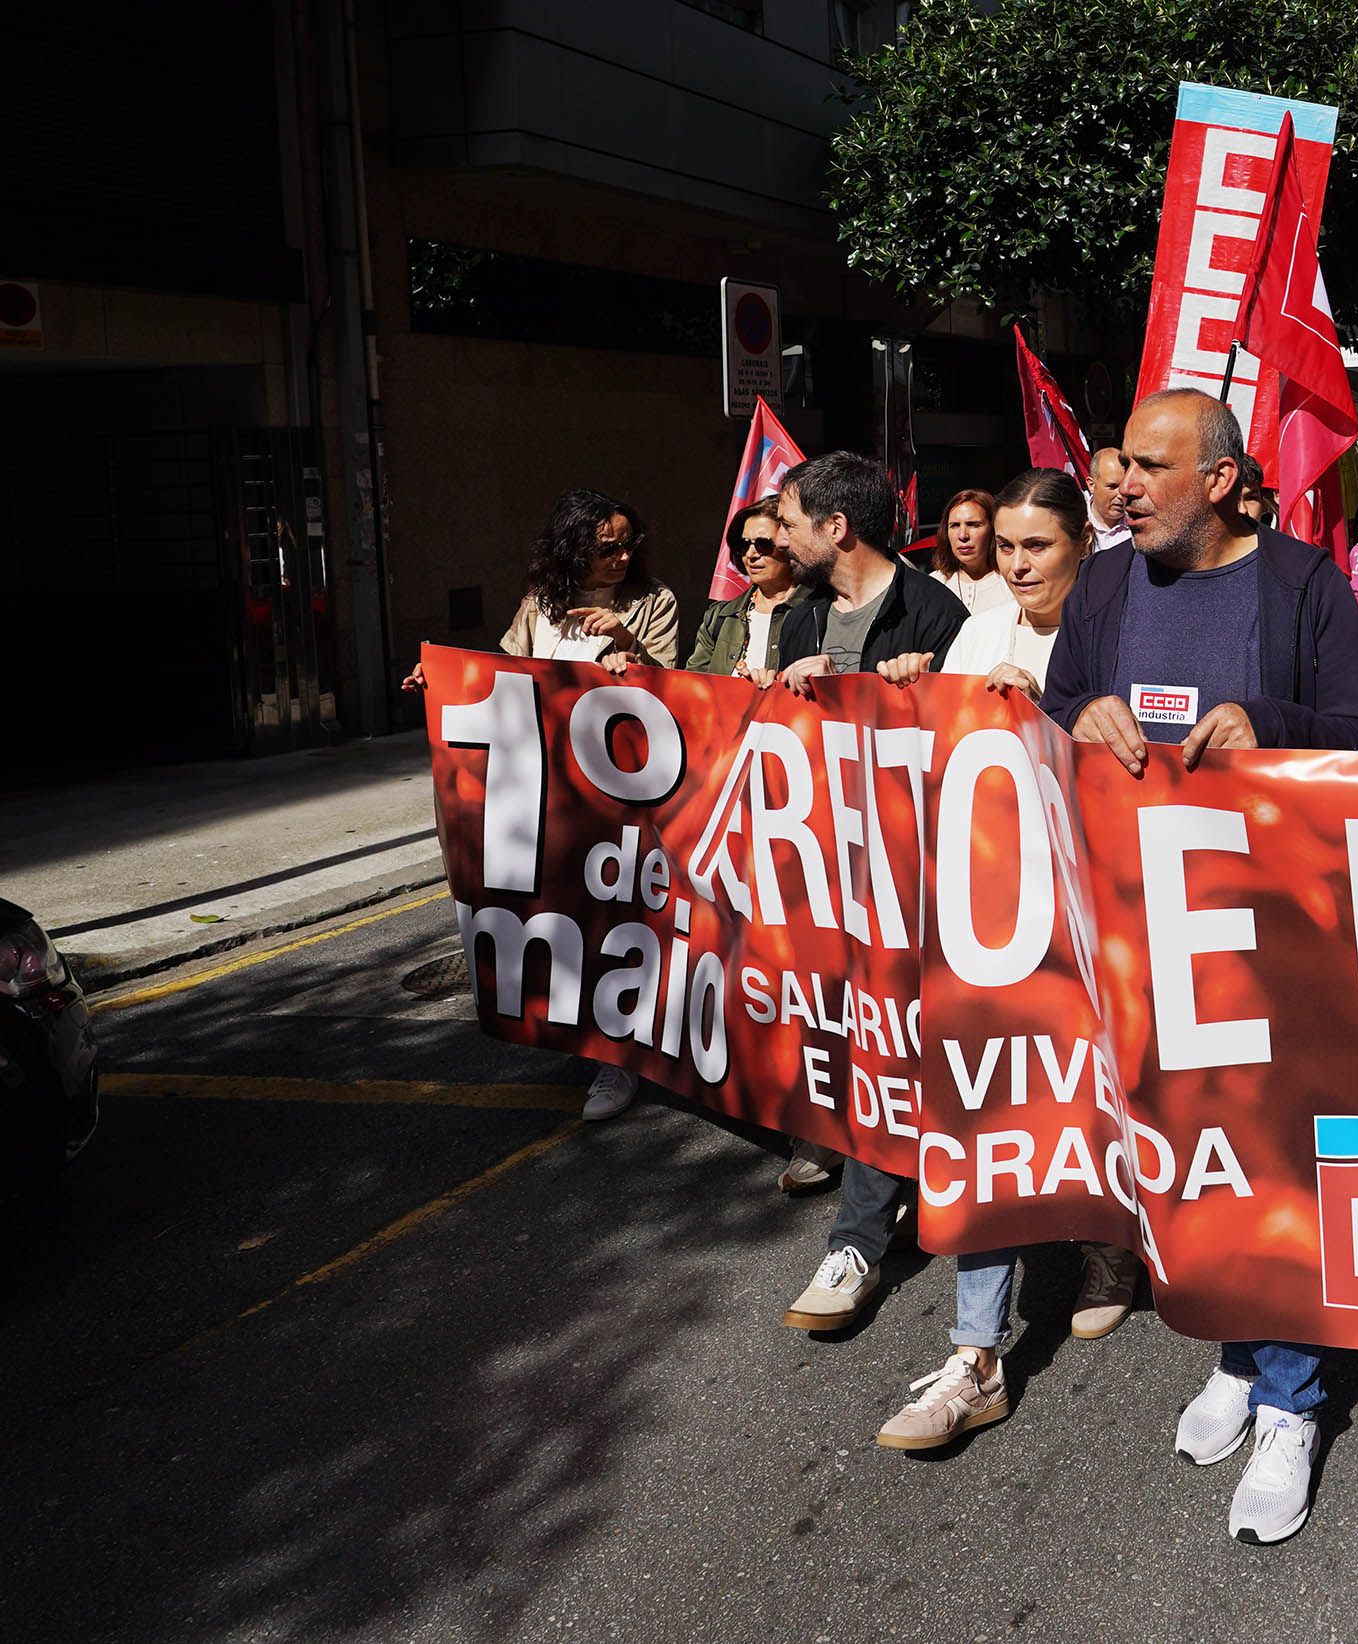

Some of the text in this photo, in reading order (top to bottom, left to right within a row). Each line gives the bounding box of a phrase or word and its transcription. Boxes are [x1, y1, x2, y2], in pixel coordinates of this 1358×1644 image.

[1138, 709, 1186, 721] industria
[1143, 695, 1186, 709] CCOO
[584, 825, 671, 911] de
[1137, 804, 1272, 1071] E
[455, 899, 728, 1084] maio
